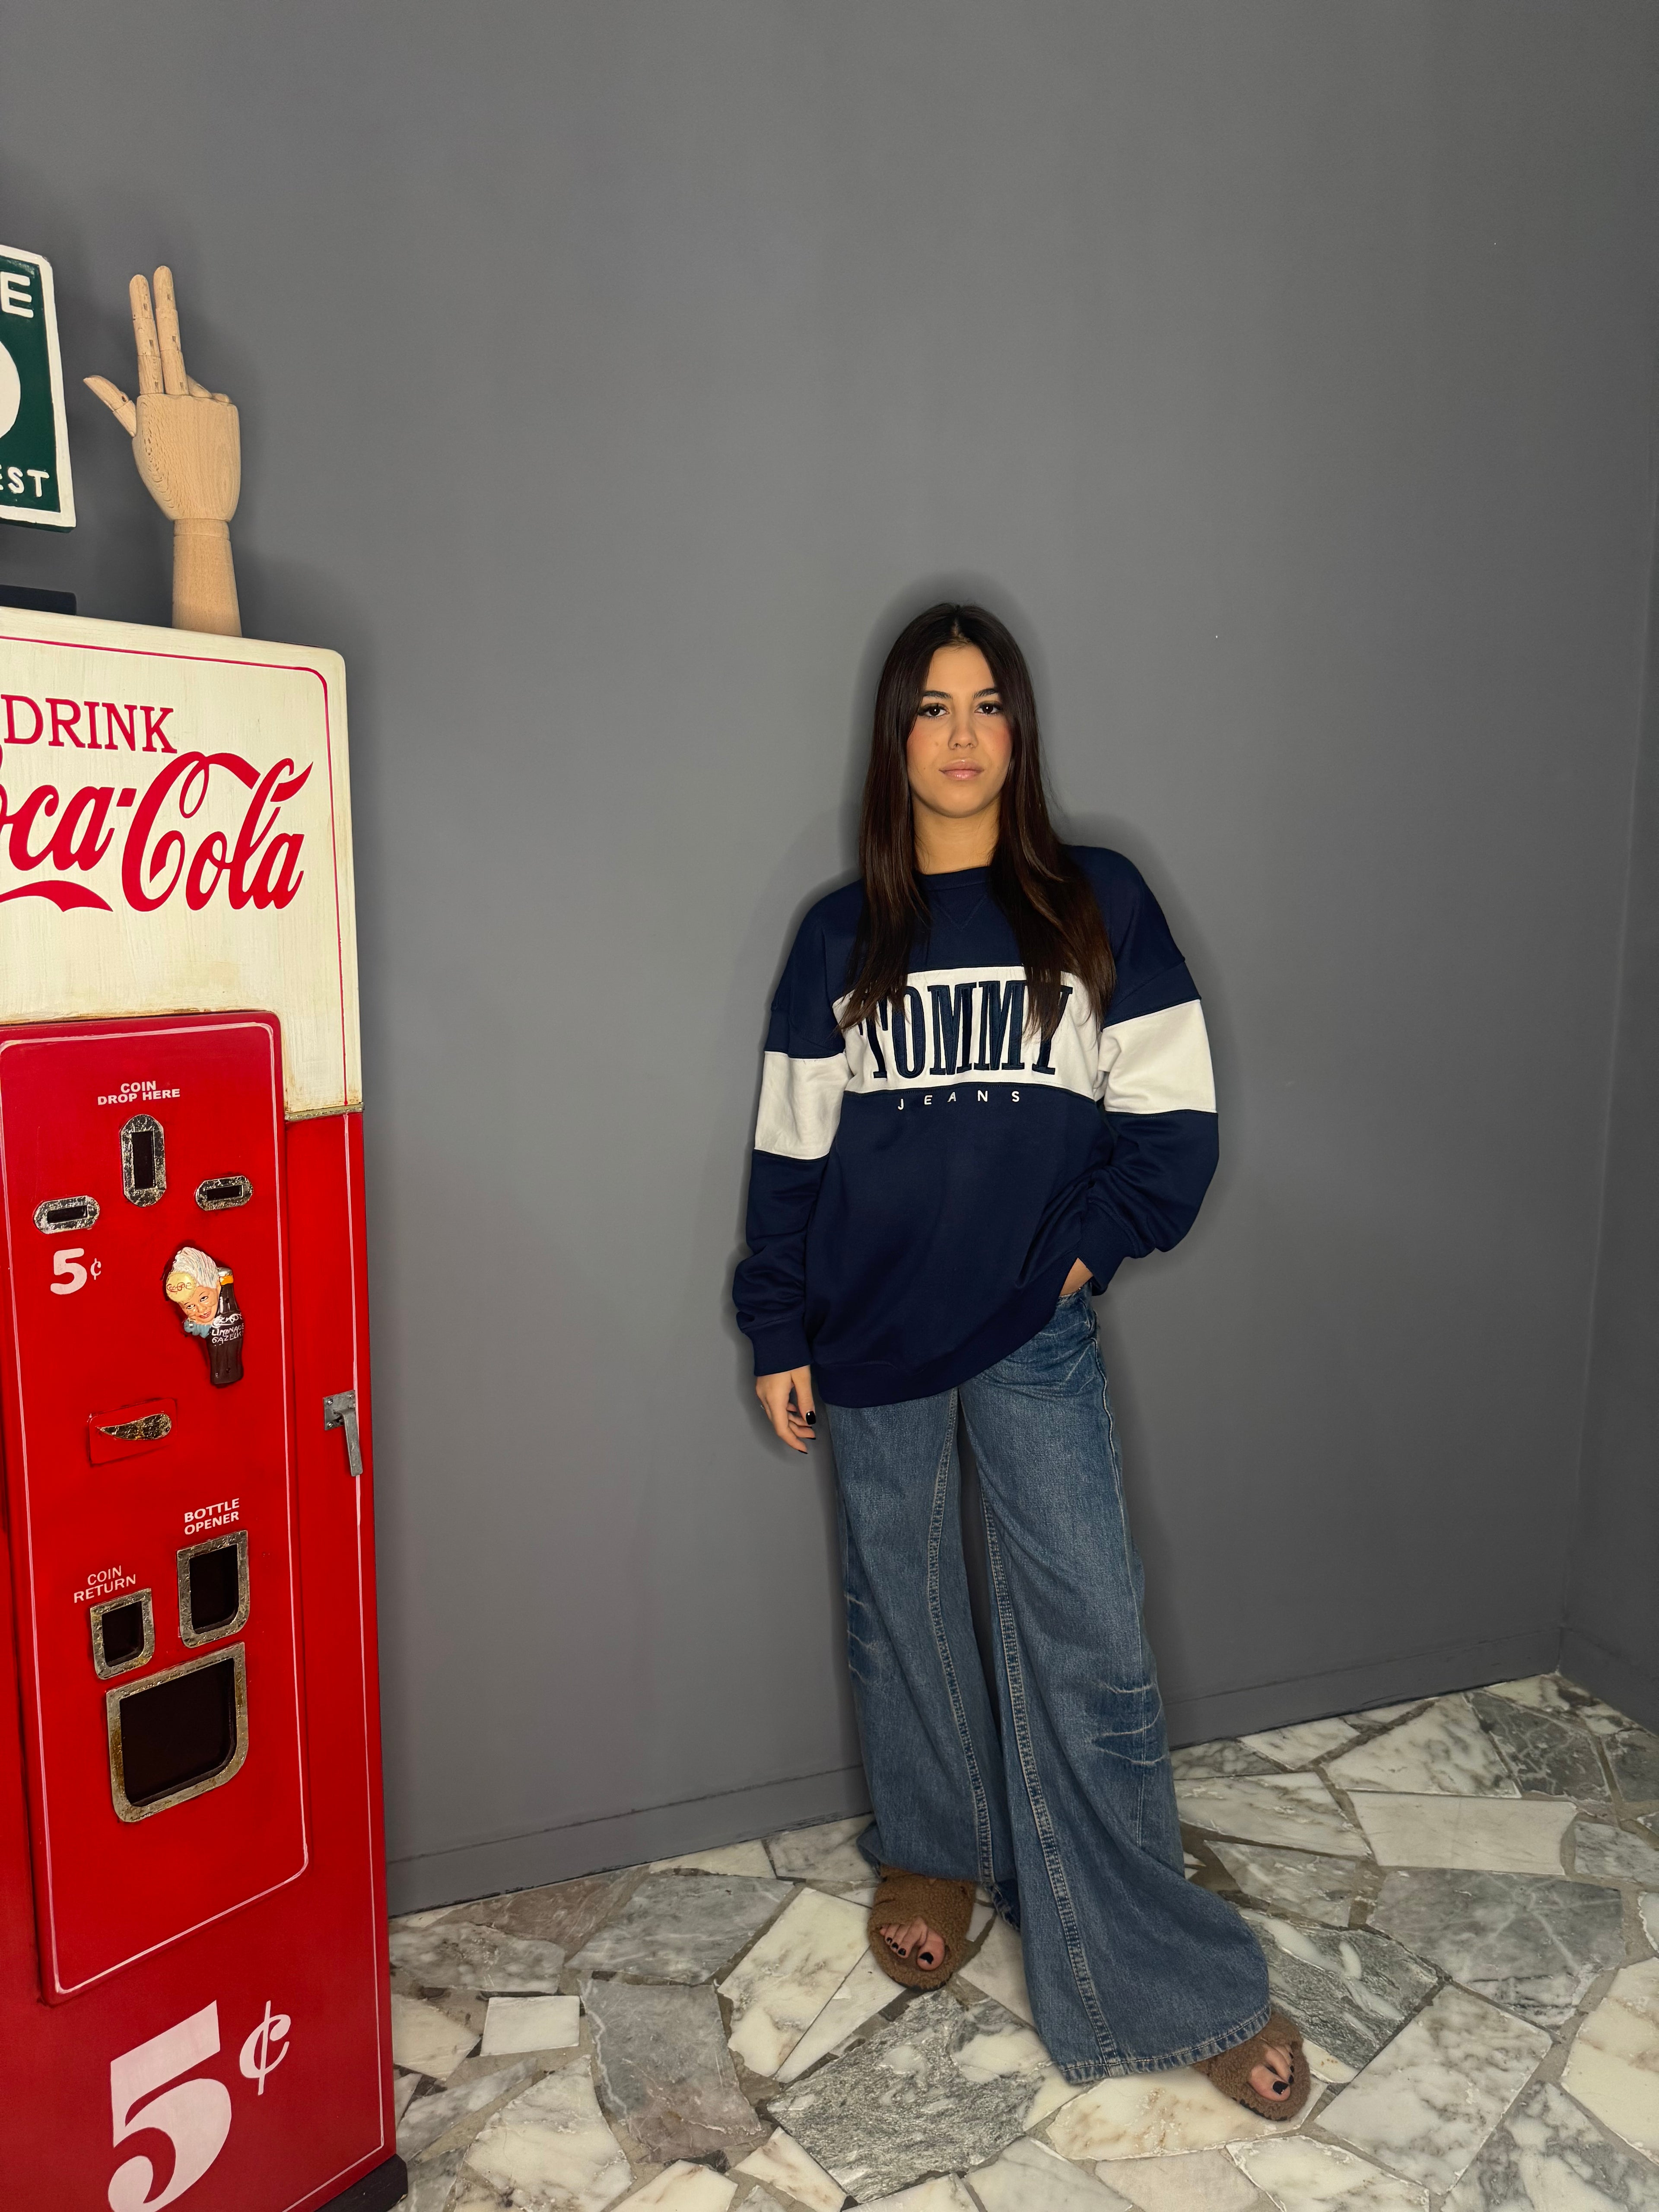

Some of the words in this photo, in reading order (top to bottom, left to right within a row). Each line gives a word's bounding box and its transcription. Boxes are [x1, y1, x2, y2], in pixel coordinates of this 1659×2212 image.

[1, 694, 178, 754] DRINK
[98, 1093, 137, 1105] DROP
[142, 1088, 181, 1101] HERE
[121, 1080, 156, 1093] COIN
[897, 1090, 1020, 1110] JEANS
[184, 1497, 240, 1523] BOTTLE
[184, 1511, 239, 1535] OPENER
[87, 1565, 122, 1586] COIN
[73, 1573, 136, 1603] RETURN
